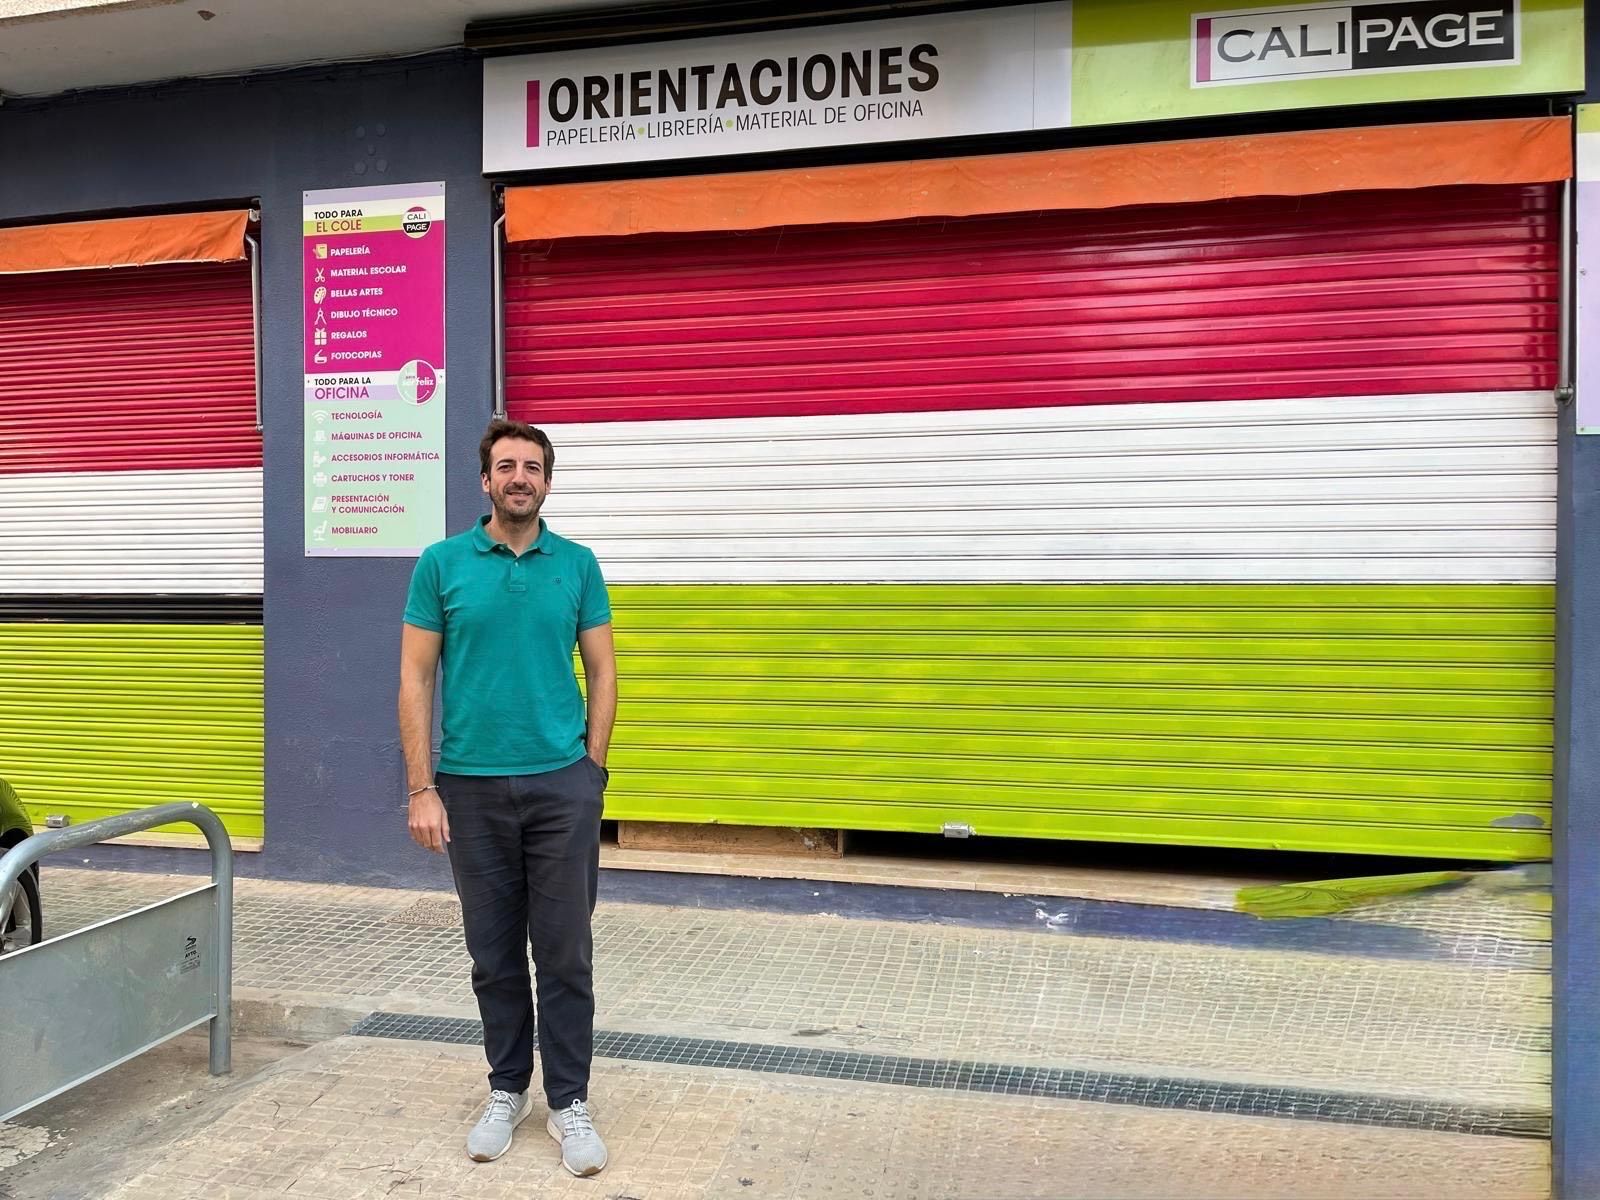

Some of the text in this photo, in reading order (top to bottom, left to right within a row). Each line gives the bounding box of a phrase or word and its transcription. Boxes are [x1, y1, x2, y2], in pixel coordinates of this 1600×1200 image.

[548, 43, 940, 123] ORIENTACIONES
[547, 99, 924, 147] PAPELERÍA LIBRERÍA MATERIAL DE OFICINA
[314, 209, 363, 220] TODO PARA
[407, 213, 427, 221] CALI
[316, 219, 362, 233] EL COLE
[406, 223, 428, 232] PAGE
[330, 245, 371, 257] PAPELERÍA
[330, 265, 407, 278] MATERIAL ESCOLAR
[330, 288, 383, 298] BELLAS ARTES
[330, 307, 398, 319] DIBUJO TÉCNICO
[331, 330, 367, 340] REGALOS
[331, 351, 382, 361] FOTOCOPIAS
[314, 377, 371, 386] TODO PARA LA
[314, 387, 370, 400] OFICINA
[331, 410, 383, 420] TECNOLOGÍA
[331, 431, 422, 441] MÁQUINAS DE OFICINA
[331, 451, 440, 462] ACCESORIOS INFORMÁTICA
[331, 474, 414, 483] CARTUCHOS Y TONER
[331, 493, 390, 503] PRESENTACIÓN
[331, 504, 405, 514] Y COMUNICACIÓN
[331, 526, 378, 535] MOBILIARIO
